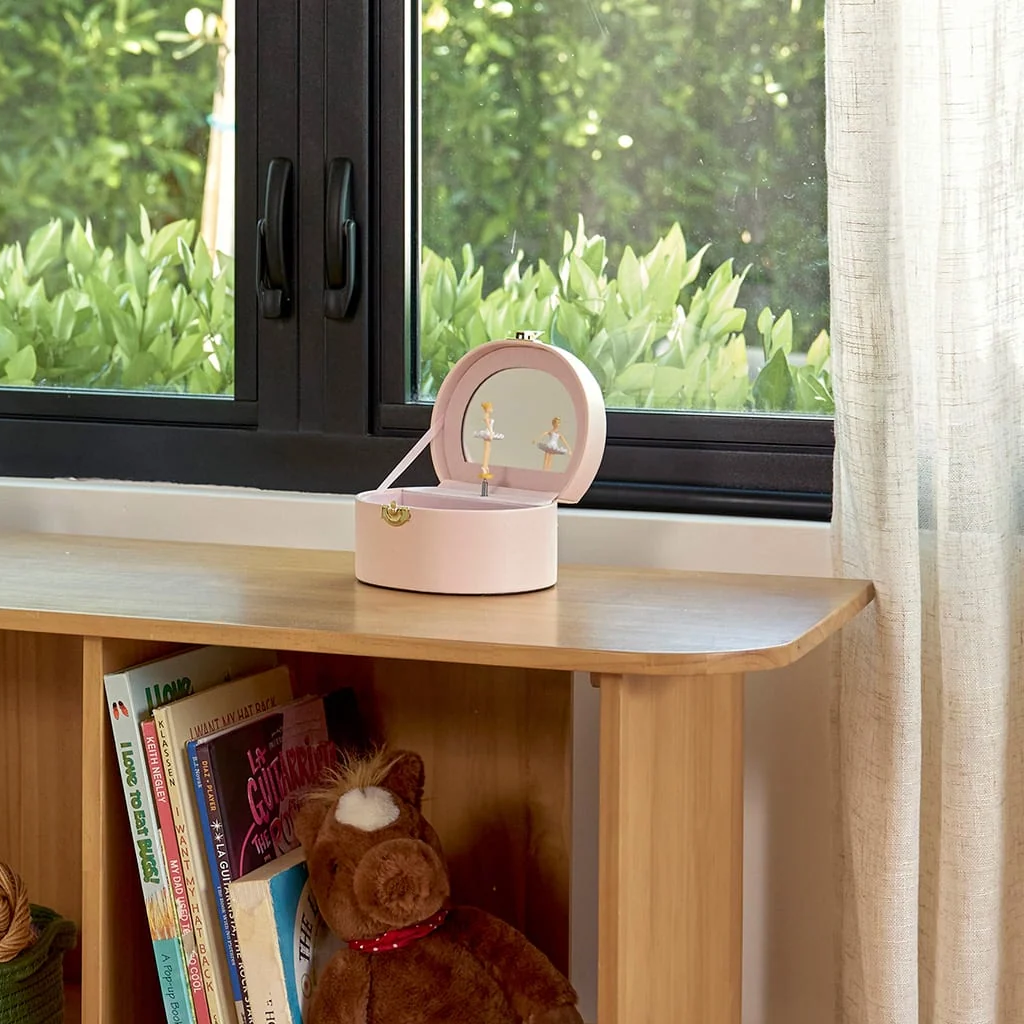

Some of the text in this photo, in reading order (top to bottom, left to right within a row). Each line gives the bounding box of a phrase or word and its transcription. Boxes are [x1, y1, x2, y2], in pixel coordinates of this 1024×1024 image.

[193, 719, 219, 737] WANT
[221, 711, 236, 725] MY
[237, 704, 254, 720] HAT
[158, 720, 175, 786] KLASSEN
[247, 746, 268, 776] LA
[146, 736, 166, 803] KEITH NEGLEY
[202, 760, 217, 811] DIAZ PLAYER
[216, 843, 226, 858] LA
[251, 829, 272, 855] THE
[170, 860, 179, 875] MY
[173, 876, 184, 895] DAD
[176, 825, 191, 870] WANT
[186, 878, 195, 896] MY
[192, 904, 204, 938] HAT
[199, 944, 214, 992] BACK
[177, 896, 190, 922] USED
[299, 914, 314, 962] THE
[161, 954, 171, 962] A
[162, 965, 176, 999] Pop-up
[190, 967, 202, 992] COOL
